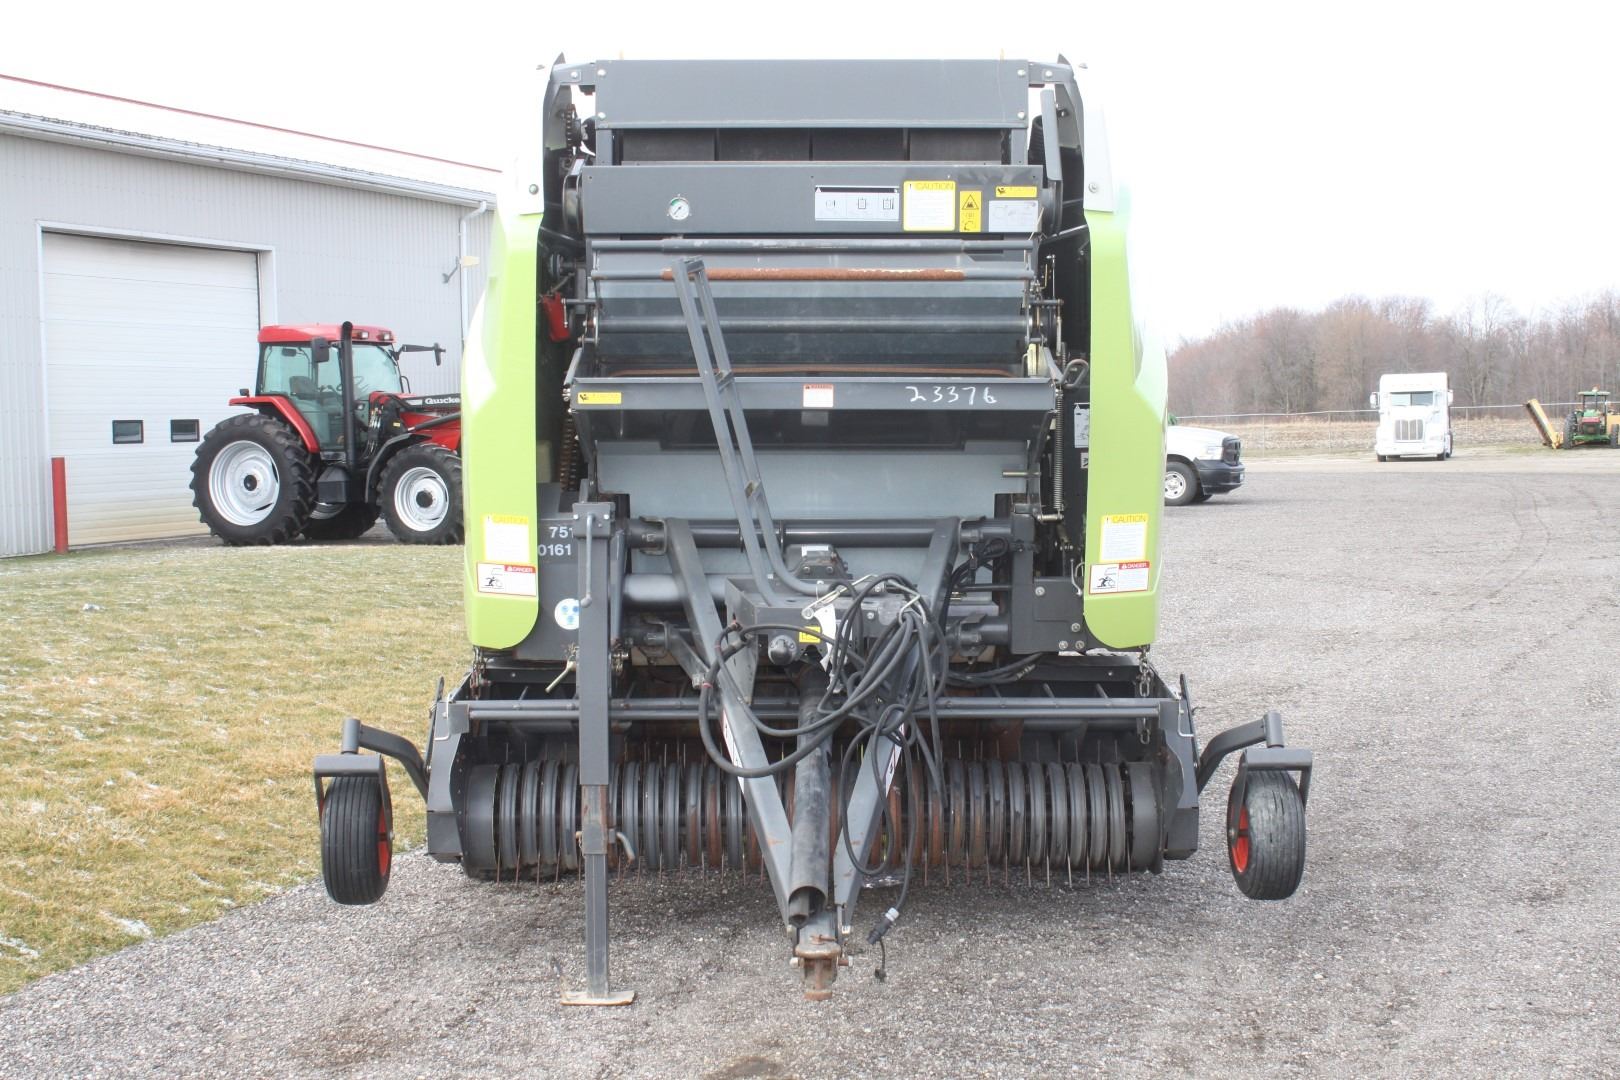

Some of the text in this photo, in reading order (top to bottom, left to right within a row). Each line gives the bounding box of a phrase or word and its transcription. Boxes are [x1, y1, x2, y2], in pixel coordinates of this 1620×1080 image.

[915, 182, 954, 191] CAUTION
[905, 385, 997, 405] 23376
[1112, 514, 1147, 524] CAUTION
[538, 543, 572, 556] 0161
[1126, 562, 1147, 570] DANGER
